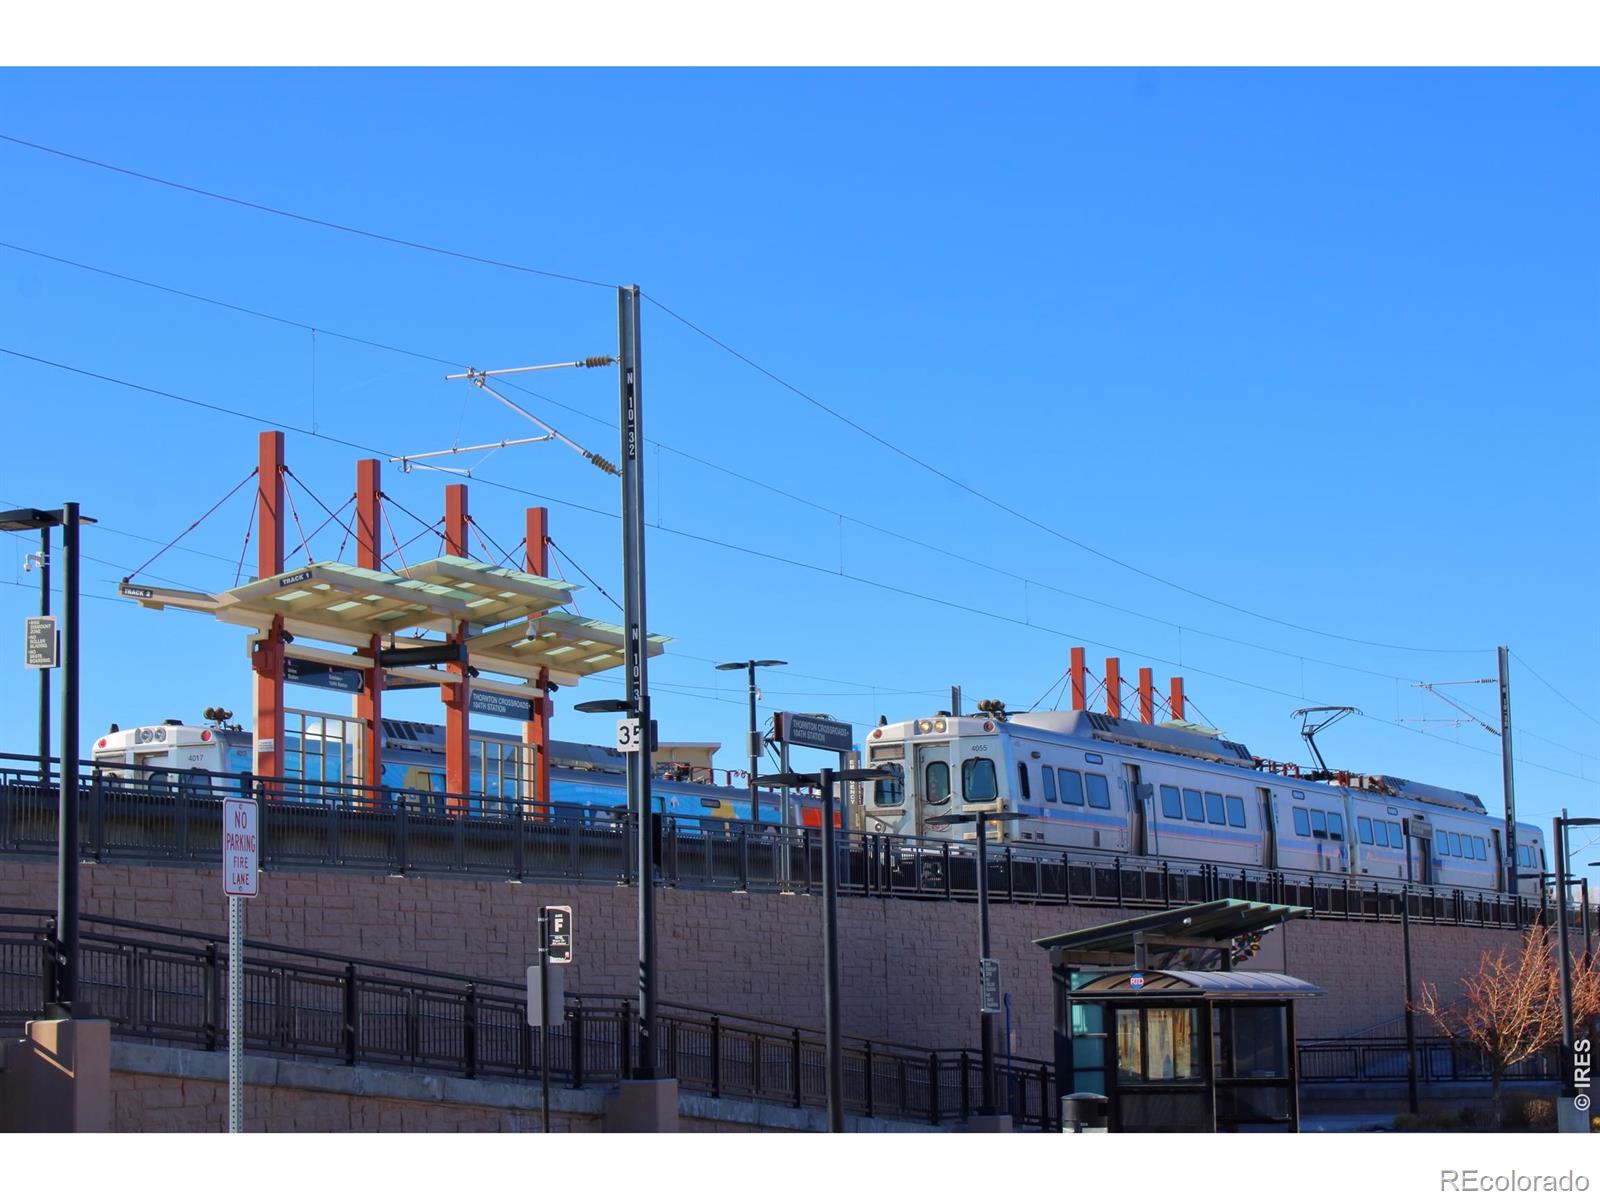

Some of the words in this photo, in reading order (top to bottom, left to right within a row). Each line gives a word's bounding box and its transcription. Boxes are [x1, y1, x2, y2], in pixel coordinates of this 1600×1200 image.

[626, 372, 633, 384] N
[283, 573, 304, 585] TRACK
[124, 587, 144, 596] TRACK
[631, 628, 639, 640] N
[473, 693, 498, 704] THORNTON
[473, 702, 487, 710] 104TH
[487, 704, 506, 712] STATION
[793, 719, 817, 732] THORNTON
[793, 729, 807, 738] 104TH
[807, 732, 825, 742] STATION
[234, 810, 248, 829] NO
[226, 833, 256, 853] PARKING
[233, 856, 249, 869] FIRE
[232, 872, 250, 886] LANE
[554, 918, 564, 932] F
